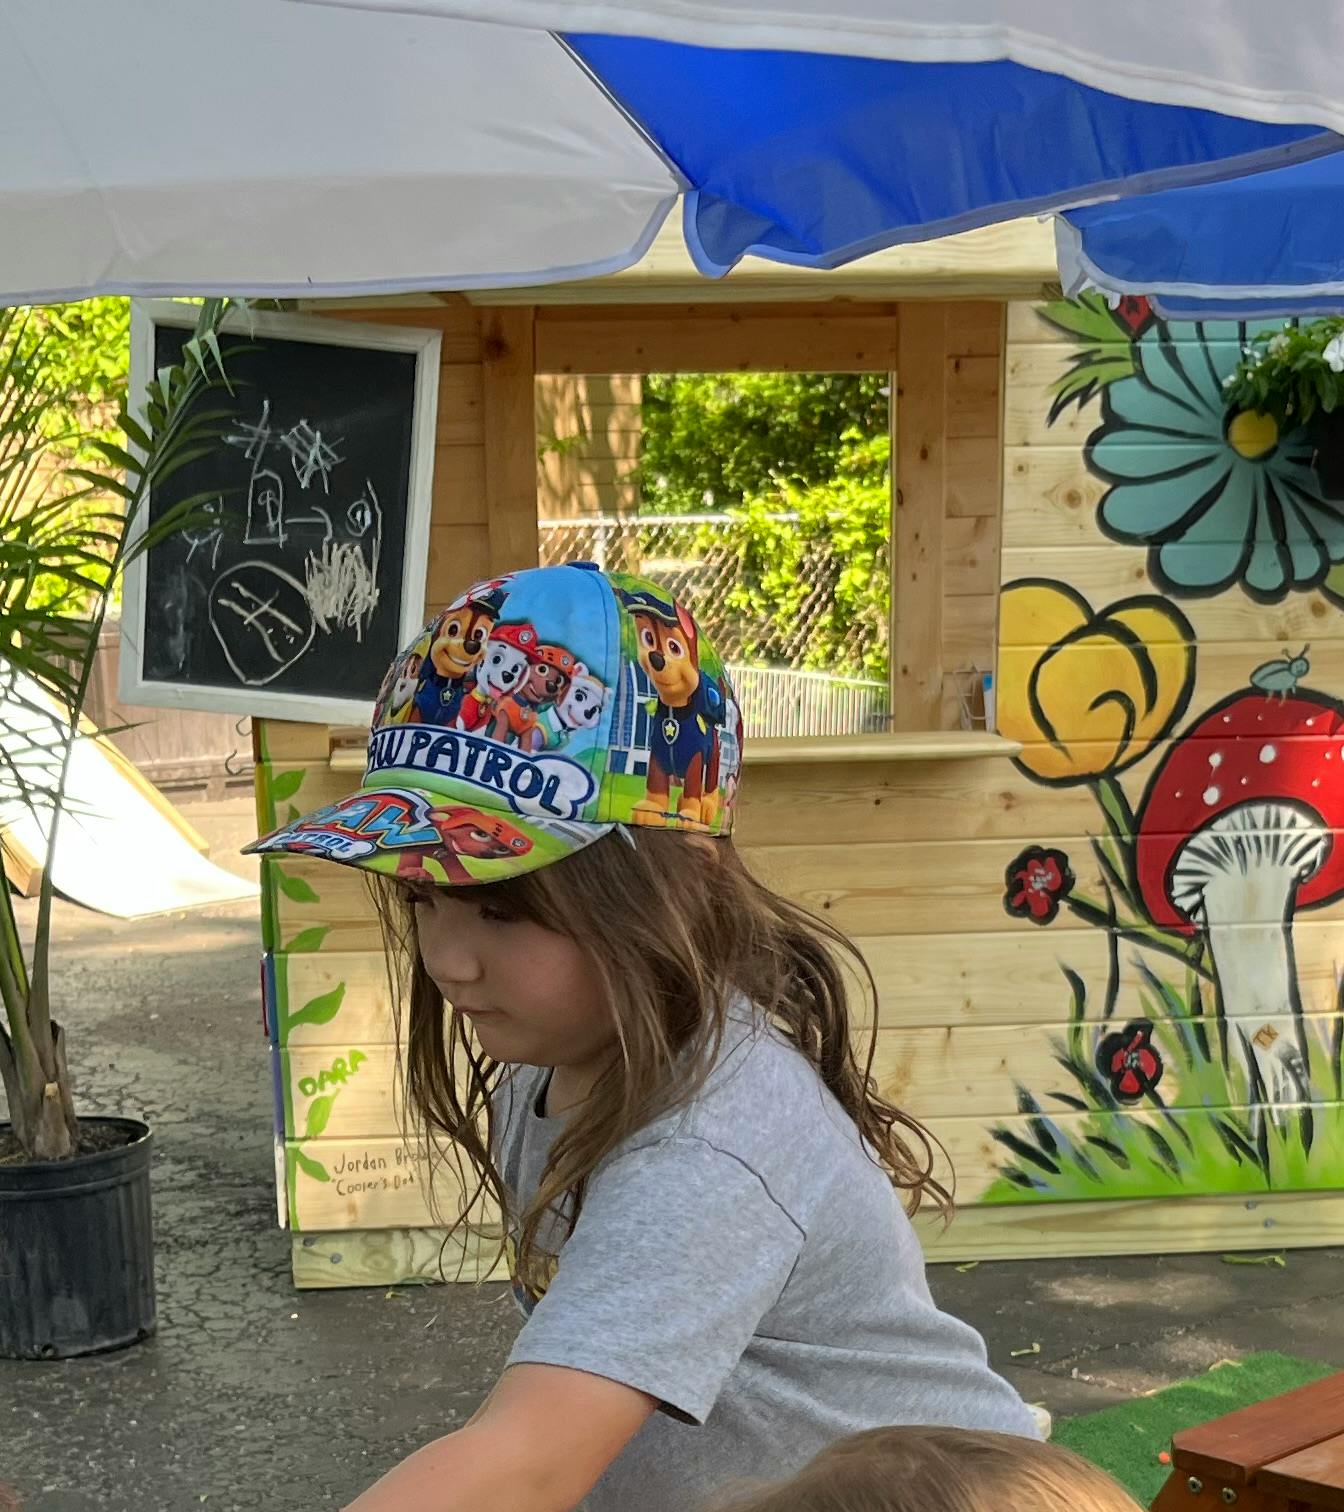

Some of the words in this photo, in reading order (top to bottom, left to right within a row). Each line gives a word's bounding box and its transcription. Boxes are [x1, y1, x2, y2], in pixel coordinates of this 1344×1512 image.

[368, 729, 406, 768] AW
[406, 730, 562, 816] PATROL
[334, 1151, 387, 1174] Jordan
